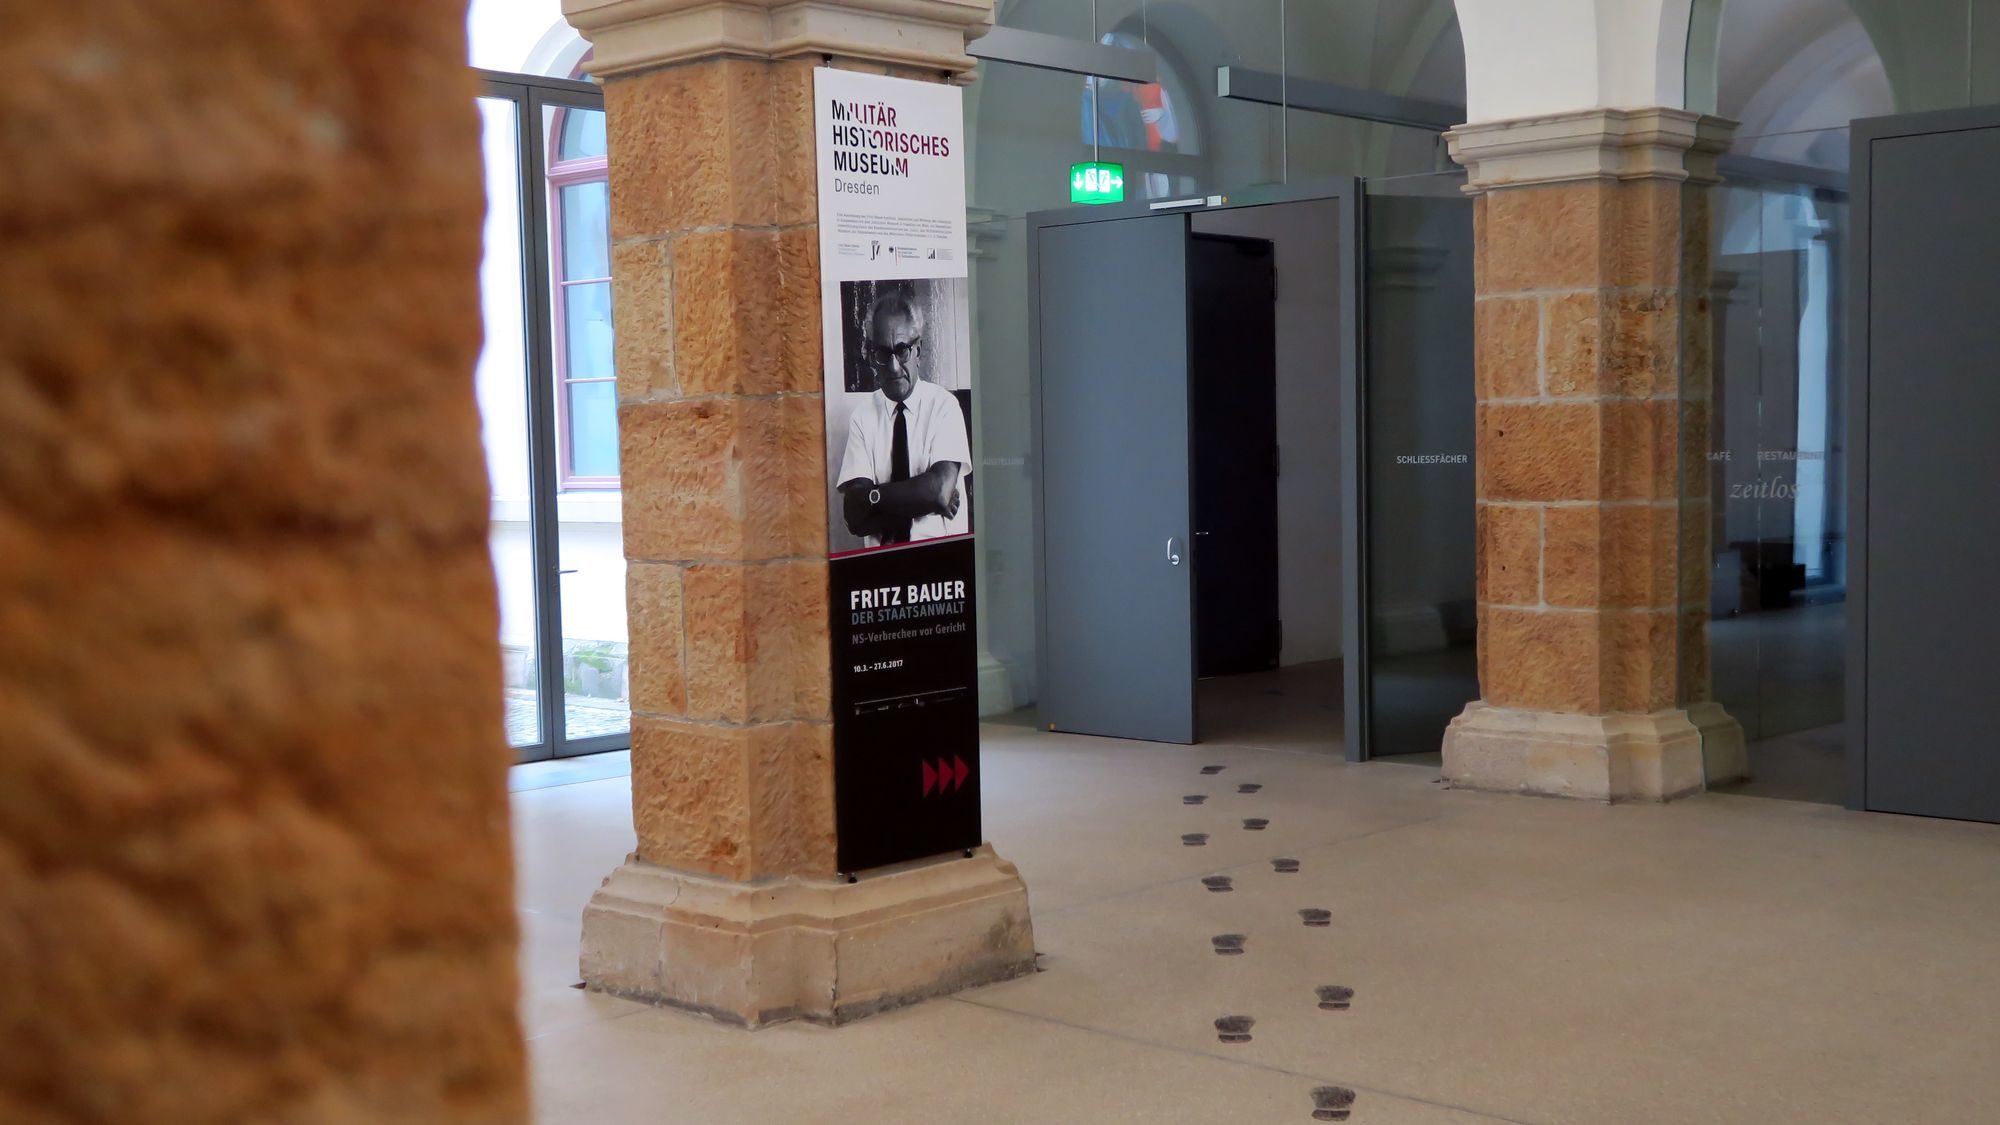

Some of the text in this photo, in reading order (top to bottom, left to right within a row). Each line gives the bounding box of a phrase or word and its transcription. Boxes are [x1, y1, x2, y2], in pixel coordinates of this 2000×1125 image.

[832, 99, 897, 127] MILITÄR
[833, 125, 949, 157] HISTORISCHES
[834, 151, 908, 178] MUSEUM
[834, 178, 880, 195] Dresden
[1396, 454, 1468, 464] SCHLIESSFÄCHER
[1706, 449, 1732, 461] CAFÉ
[1730, 476, 1800, 499] zeitlos
[851, 580, 965, 610] FRITZ BAUER
[851, 601, 965, 625] DER STAATSANWALT
[852, 622, 966, 645] NS-Verbrechen vor Gericht
[874, 660, 904, 670] 27.6.2017
